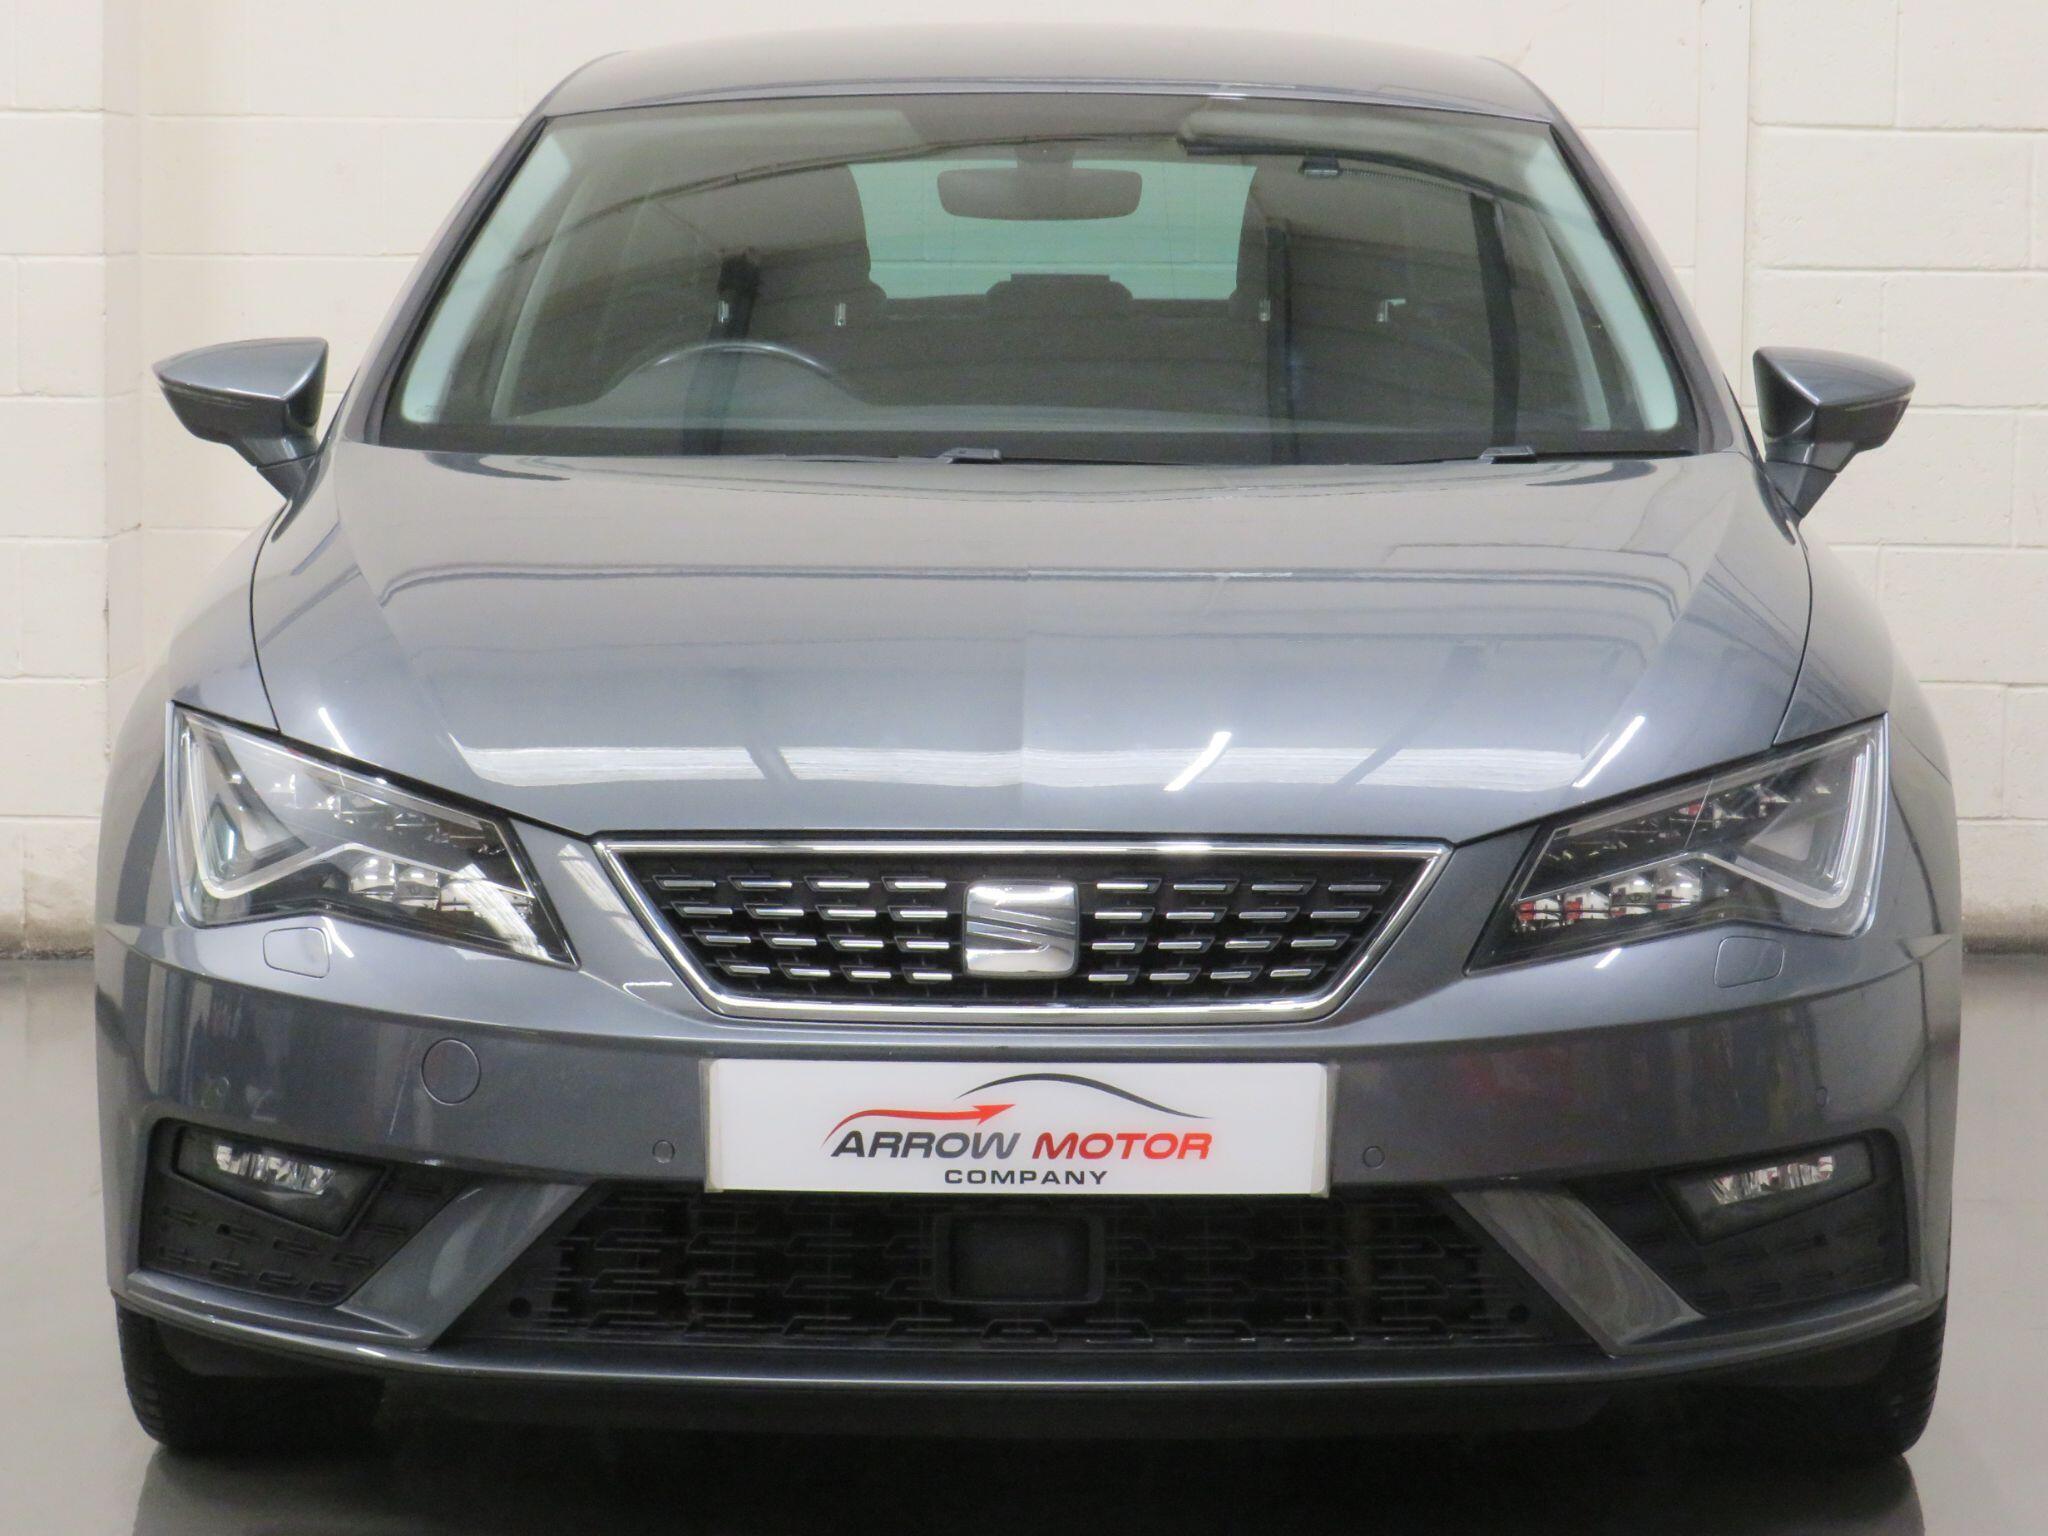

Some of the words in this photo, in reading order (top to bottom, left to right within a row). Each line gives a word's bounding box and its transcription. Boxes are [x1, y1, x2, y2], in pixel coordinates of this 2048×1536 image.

[831, 1130, 1021, 1160] ARROW
[1032, 1132, 1213, 1160] MOTOR
[944, 1169, 1108, 1186] COMPANY
